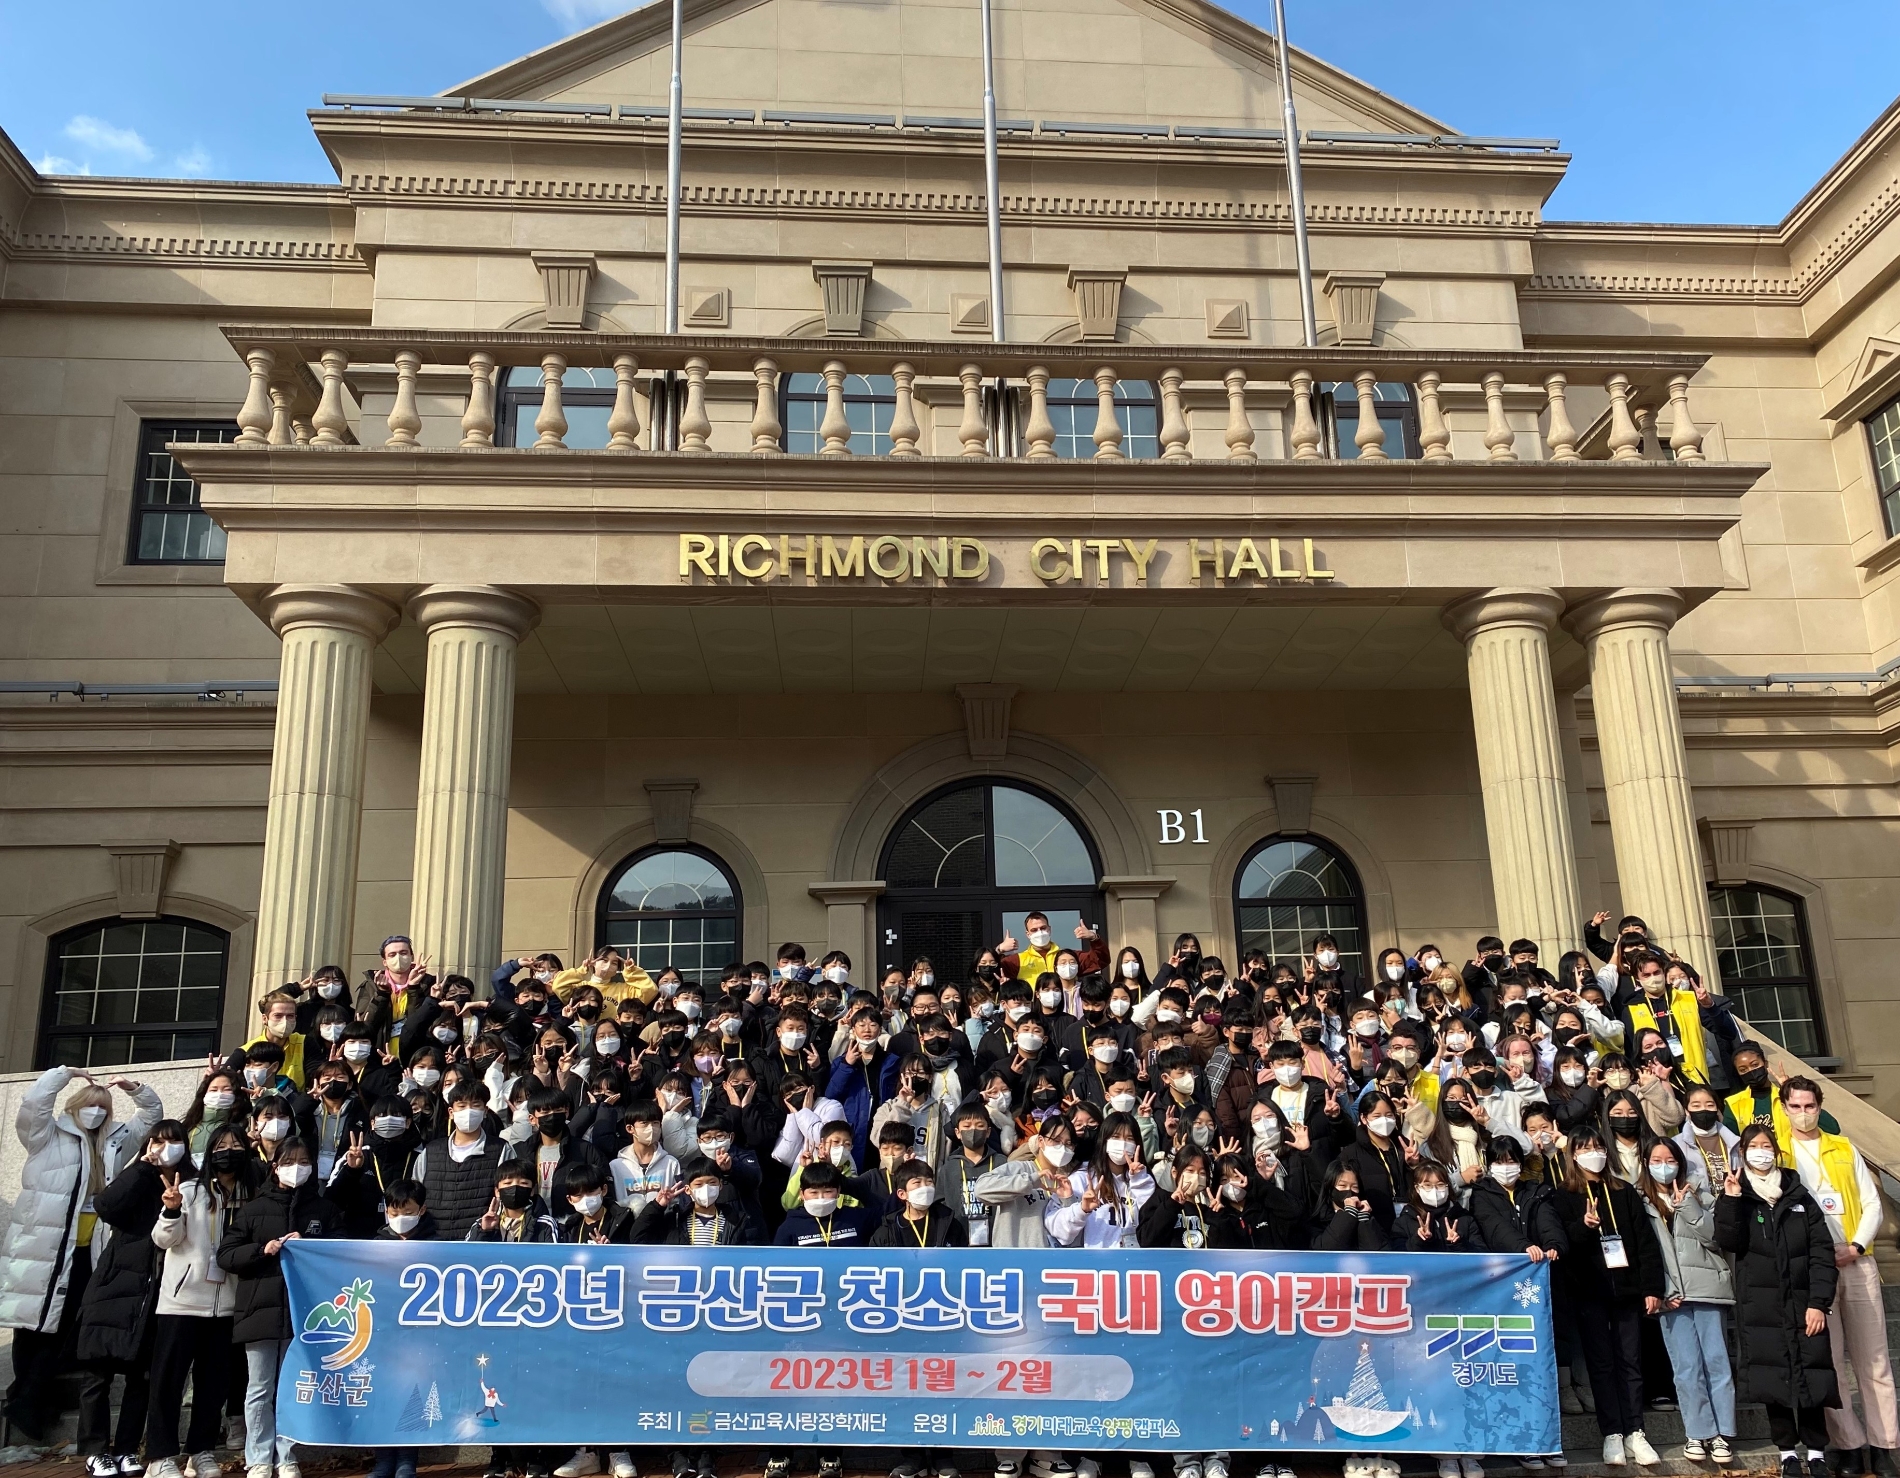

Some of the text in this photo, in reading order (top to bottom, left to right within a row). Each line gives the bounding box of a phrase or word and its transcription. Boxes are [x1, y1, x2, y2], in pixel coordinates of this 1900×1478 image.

[679, 534, 1335, 580] RICHMOND CITY HALL
[1157, 808, 1209, 844] B1
[398, 1264, 1413, 1336] 2023년 금산군 청소년 국내 영어캠프
[296, 1370, 373, 1407] 금산군
[769, 1358, 893, 1390] 2023년
[905, 1358, 955, 1391] 1월
[996, 1360, 1052, 1393] 2월
[1452, 1362, 1519, 1387] 경기도
[637, 1411, 887, 1432] 주최 금산교육사랑장학재단
[913, 1413, 947, 1434] 운영
